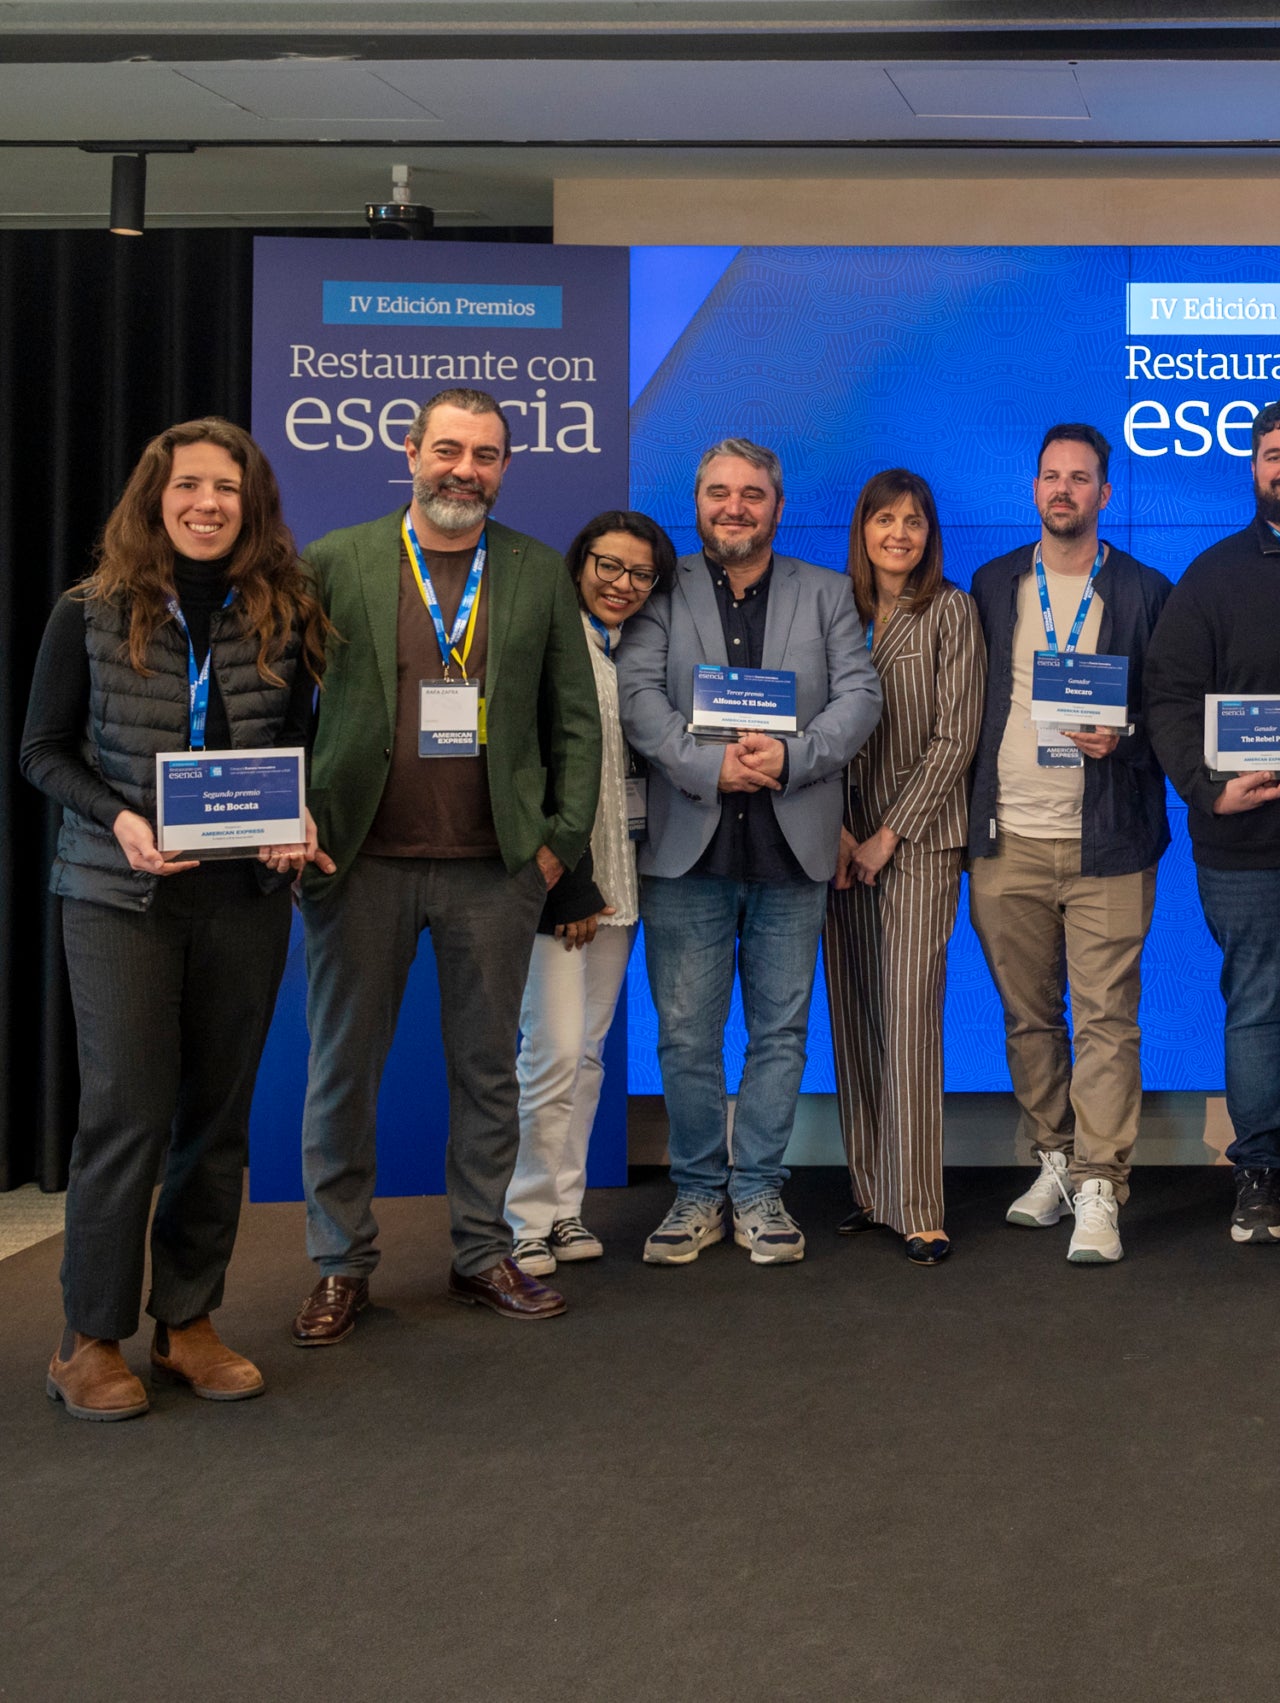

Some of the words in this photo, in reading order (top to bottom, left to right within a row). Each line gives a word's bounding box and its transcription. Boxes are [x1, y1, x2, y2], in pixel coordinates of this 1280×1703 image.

[350, 296, 372, 313] IV
[376, 296, 450, 315] Edición
[456, 298, 536, 316] Premios
[1149, 298, 1178, 320] IV
[1182, 296, 1276, 320] Edición
[290, 344, 518, 382] Restaurante
[527, 356, 596, 382] con
[286, 388, 602, 454] esecia
[169, 770, 203, 779] esencia
[203, 790, 234, 799] Segundo
[234, 789, 261, 799] premio
[213, 803, 225, 811] de
[226, 802, 259, 811] Bocata
